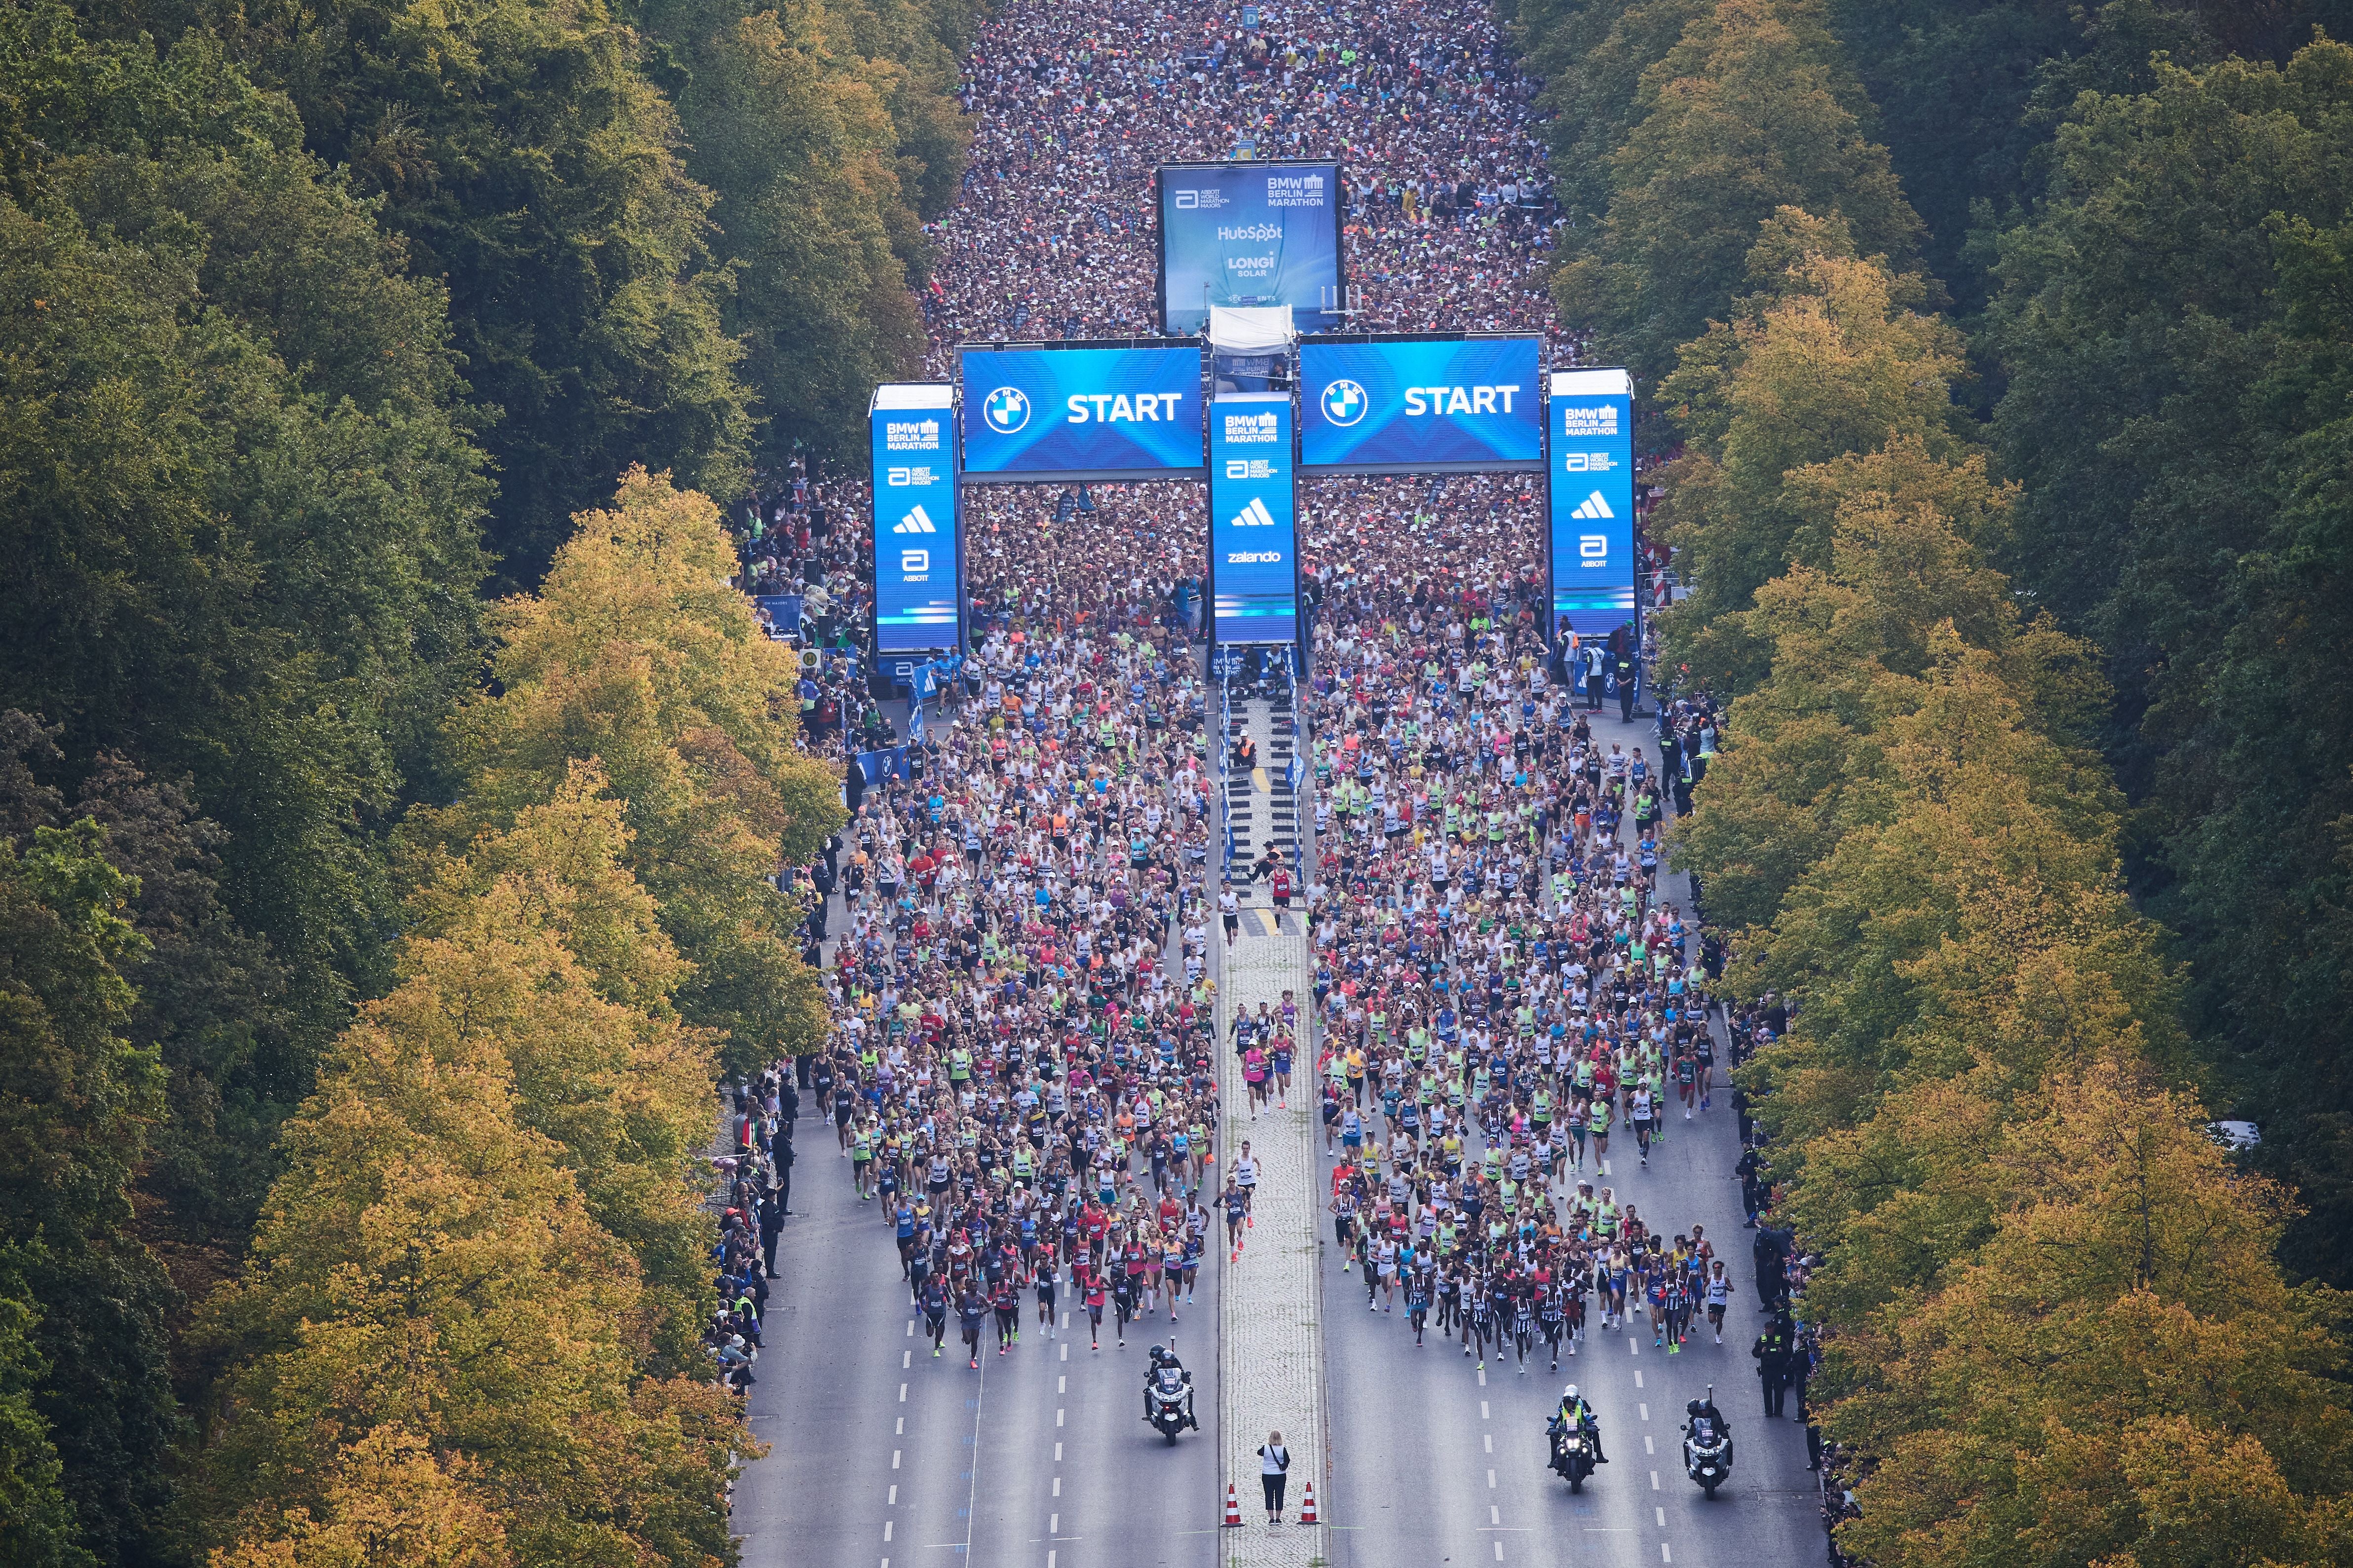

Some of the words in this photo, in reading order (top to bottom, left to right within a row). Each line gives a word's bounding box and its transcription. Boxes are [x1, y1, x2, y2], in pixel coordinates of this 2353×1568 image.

[1268, 177, 1302, 189] BMW
[1218, 224, 1283, 242] HubSpot
[1327, 382, 1361, 397] BMW
[990, 389, 1024, 403] BMW
[1405, 385, 1519, 416] START
[1067, 393, 1182, 423] START
[1565, 409, 1598, 420] BMW
[1225, 415, 1258, 427] BMW
[1565, 419, 1598, 428] BERLIN
[887, 423, 919, 434] BMW
[1565, 427, 1617, 436] MARATHON
[1225, 434, 1277, 443] MARATHON
[887, 442, 939, 450] MARATHON
[1228, 551, 1281, 563] zalando
